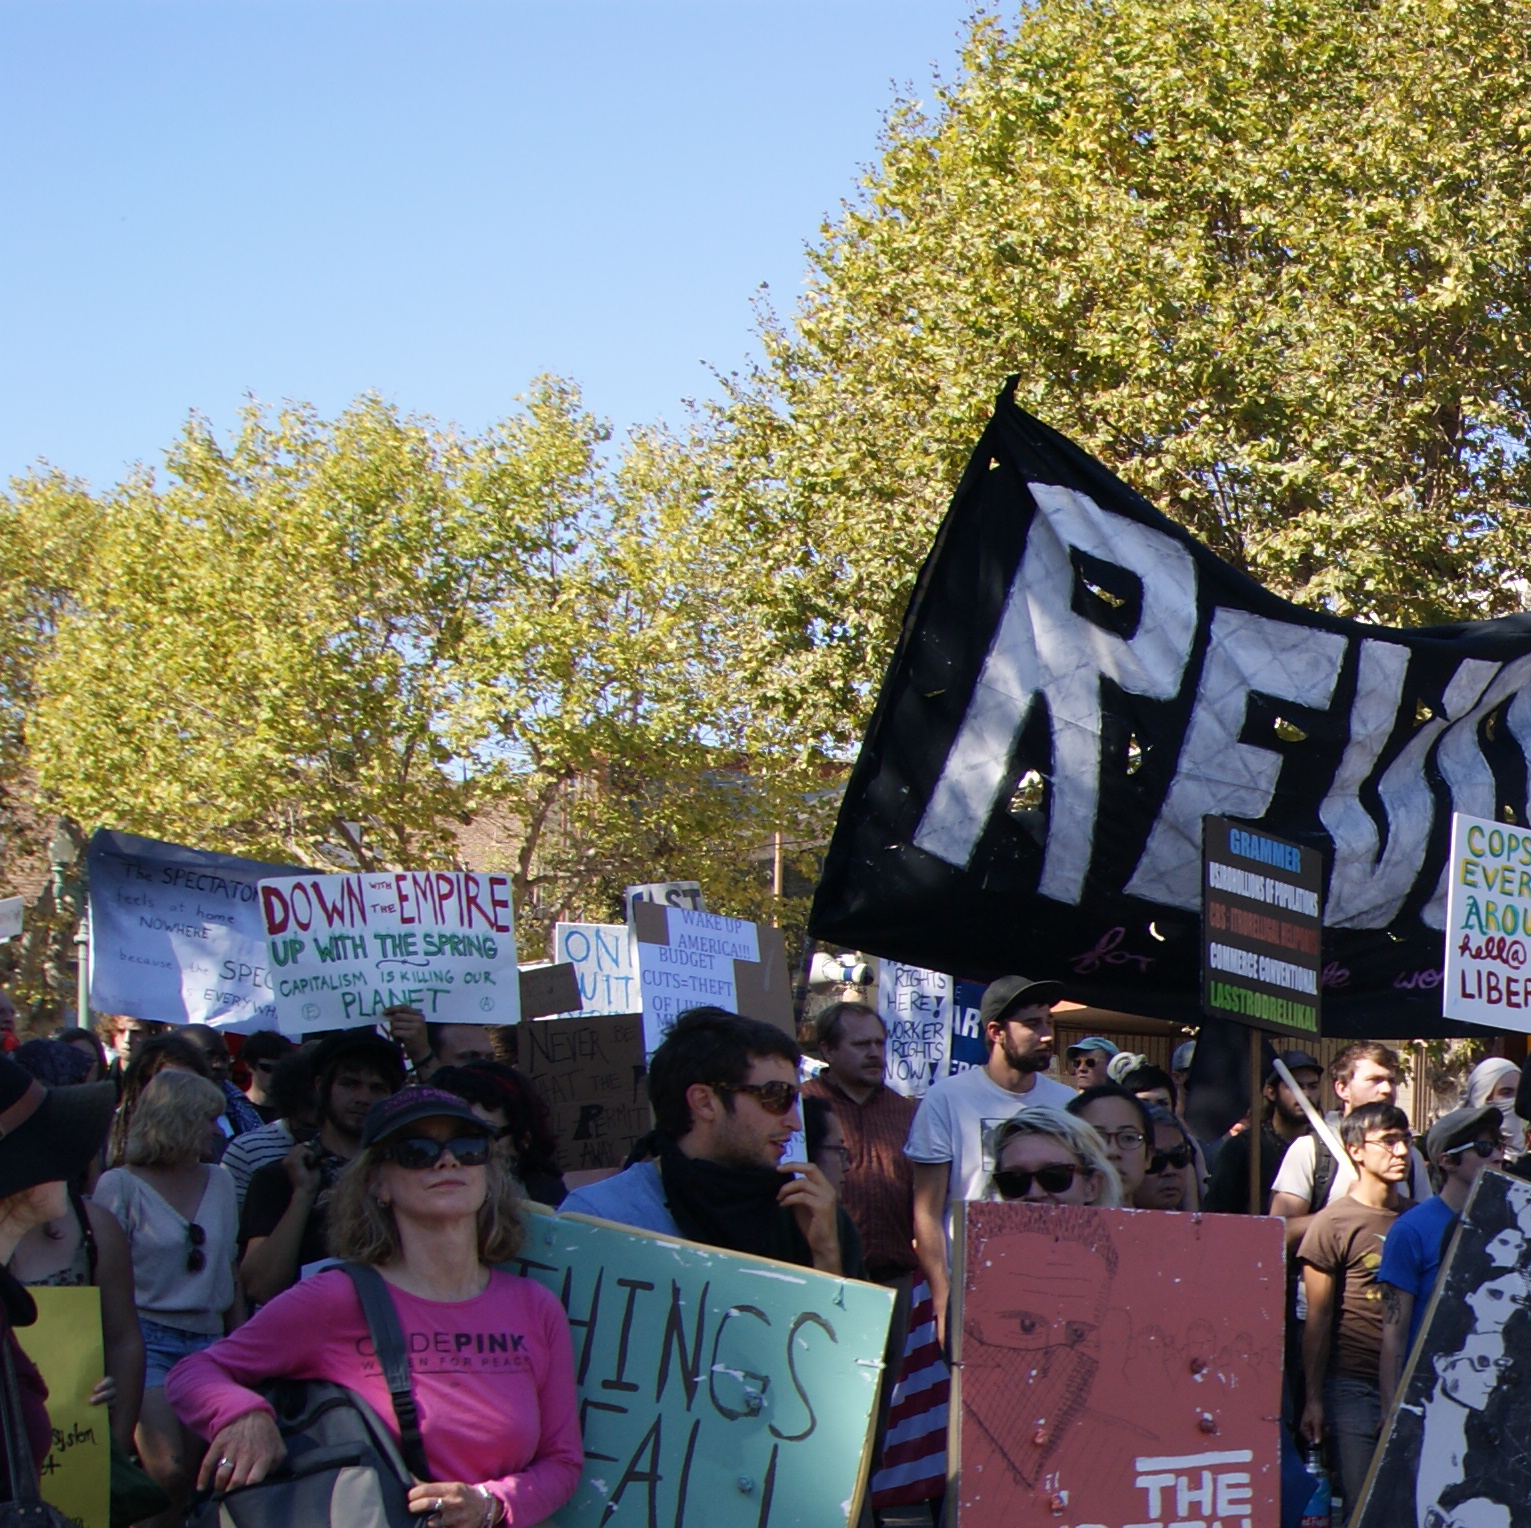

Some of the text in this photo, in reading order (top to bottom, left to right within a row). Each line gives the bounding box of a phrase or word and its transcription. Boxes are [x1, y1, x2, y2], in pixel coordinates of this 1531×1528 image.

[1229, 828, 1300, 874] GRAMMER
[197, 906, 236, 924] home
[261, 873, 510, 935] DOWN WITH THE EMPIRE
[681, 909, 742, 935] WAKE UP
[270, 933, 498, 967] UP WITH THE SPRING
[659, 947, 715, 970] BUDGET
[679, 933, 751, 959] AMERICA!!!
[119, 951, 173, 970] because
[1210, 942, 1258, 981] COMMERCE
[1259, 954, 1317, 995] CONVENTIONAL
[279, 969, 496, 997] CAPITALISM IS KILLING OUR
[642, 970, 733, 997] CUTS=THEFT
[895, 967, 946, 990] RIGHTS
[341, 988, 450, 1018] PLANET
[653, 996, 674, 1012] OF
[888, 991, 946, 1018] HERE!
[887, 1020, 944, 1040] WORKER
[528, 1021, 608, 1073] NEVER
[892, 1040, 943, 1062] RIGHTS
[884, 1059, 939, 1086] NOW!
[356, 1332, 528, 1356] CDEPINK
[362, 1357, 428, 1370] WEN
[1134, 1471, 1252, 1519] THE
